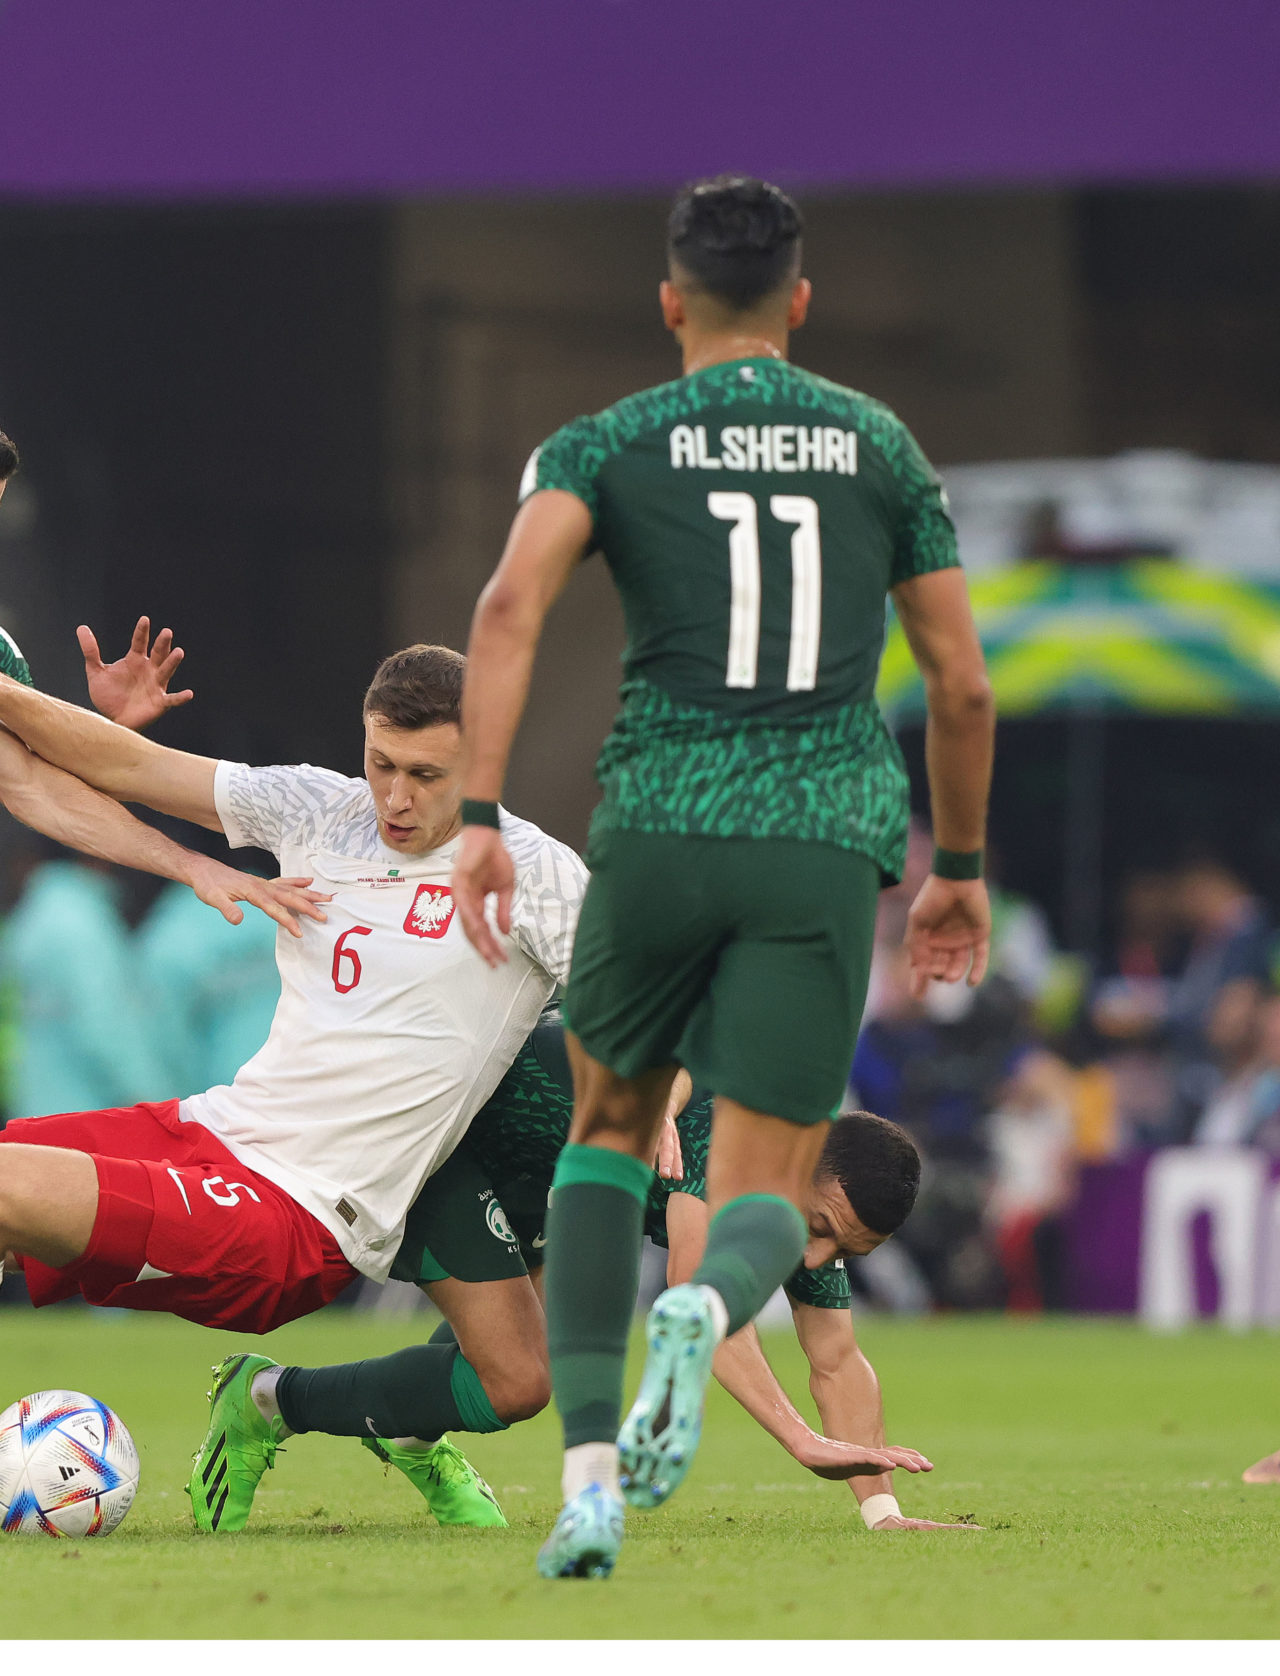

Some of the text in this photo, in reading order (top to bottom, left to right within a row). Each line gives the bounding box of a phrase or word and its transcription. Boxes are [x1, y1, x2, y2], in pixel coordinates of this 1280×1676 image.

[670, 424, 858, 476] ALSHEHRI
[707, 491, 821, 691] 11
[332, 925, 373, 994] 6
